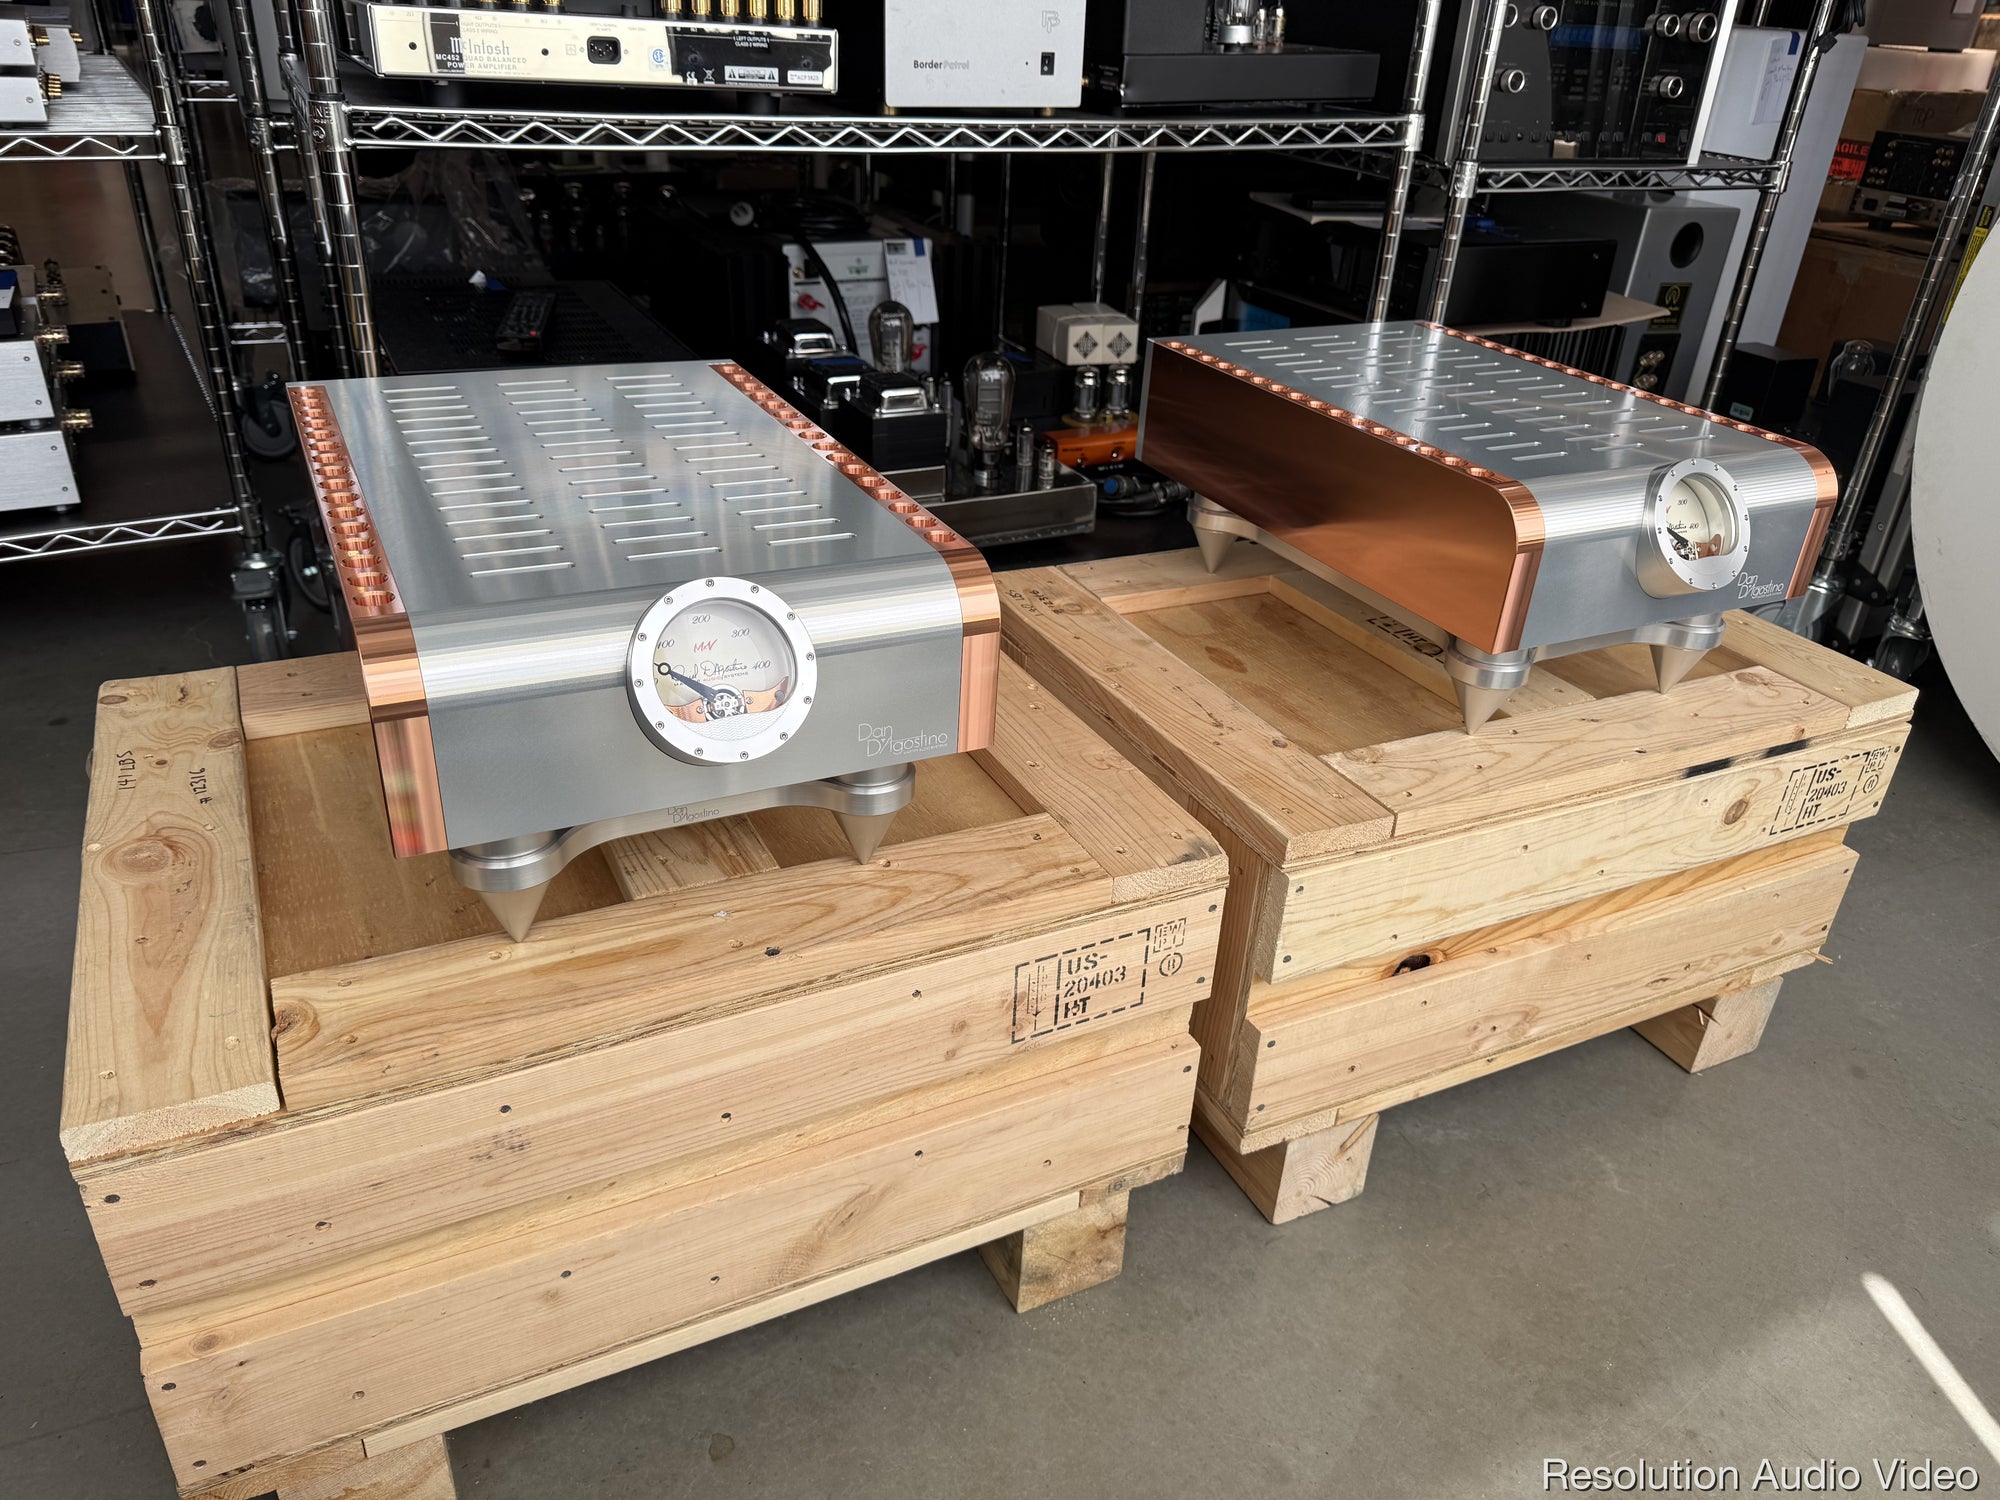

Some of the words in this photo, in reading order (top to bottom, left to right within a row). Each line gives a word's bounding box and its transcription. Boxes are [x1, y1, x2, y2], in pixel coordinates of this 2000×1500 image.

[435, 53, 460, 61] MC452
[486, 56, 527, 64] BALANCED
[478, 62, 517, 70] AMPLIFIER
[1737, 572, 1758, 587] Dan
[692, 614, 711, 625] 200
[731, 628, 750, 638] 300
[656, 639, 675, 649] 100
[751, 660, 771, 671] 400
[858, 723, 893, 742] Dan
[867, 729, 948, 757] D'Agostino
[116, 750, 136, 771] LBS
[117, 774, 136, 790] 141
[1808, 781, 1848, 803] 20403
[667, 806, 688, 816] Dan
[1802, 803, 1822, 820] HT
[1063, 965, 1127, 998] 20403
[1063, 996, 1091, 1019] HT
